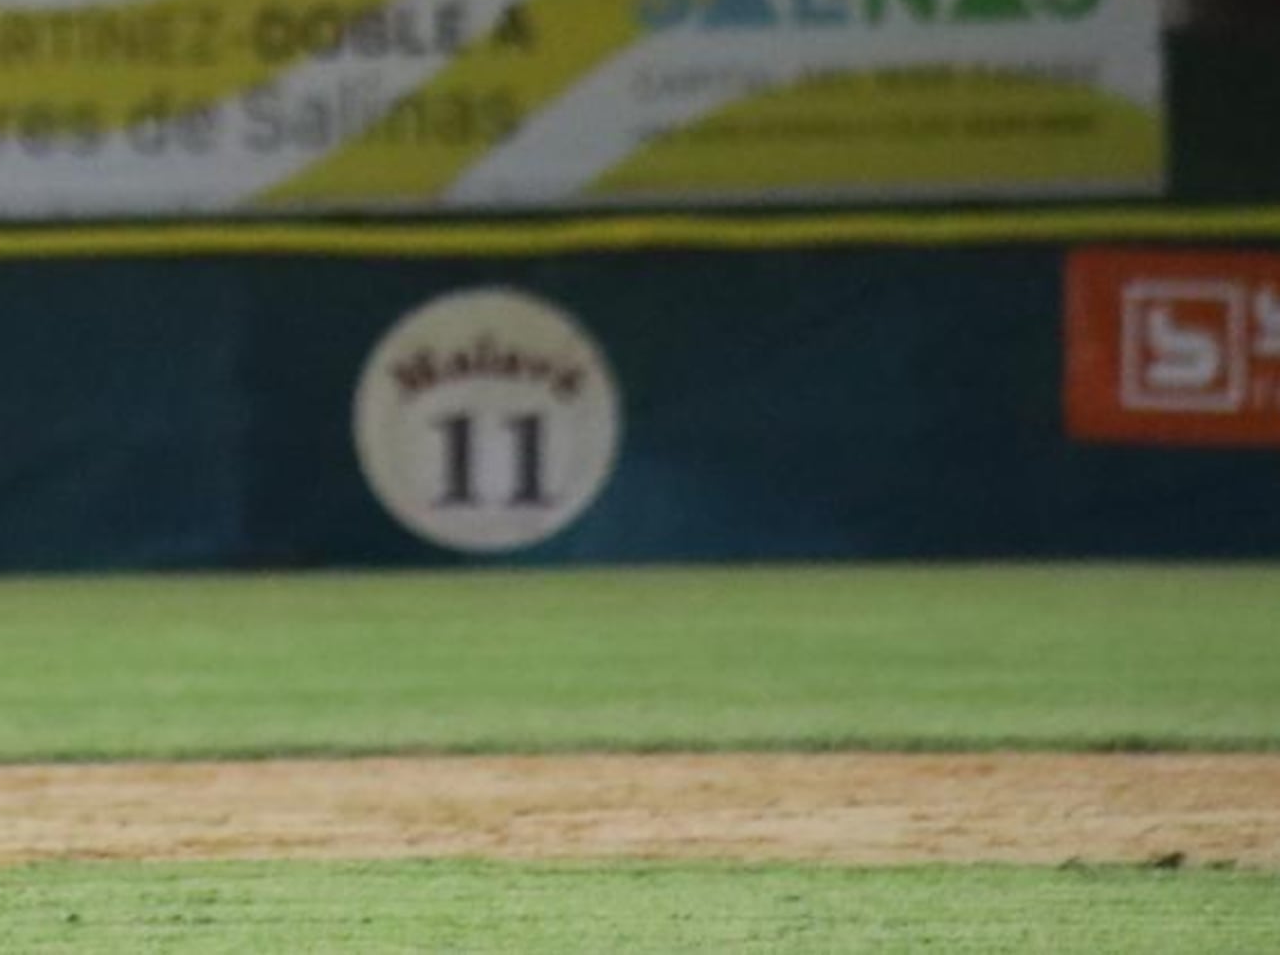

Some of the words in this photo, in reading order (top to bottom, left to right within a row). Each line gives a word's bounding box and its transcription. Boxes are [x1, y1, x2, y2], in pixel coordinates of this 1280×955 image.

[125, 85, 219, 154] de
[244, 73, 528, 151] Salinas
[430, 407, 556, 511] 11
